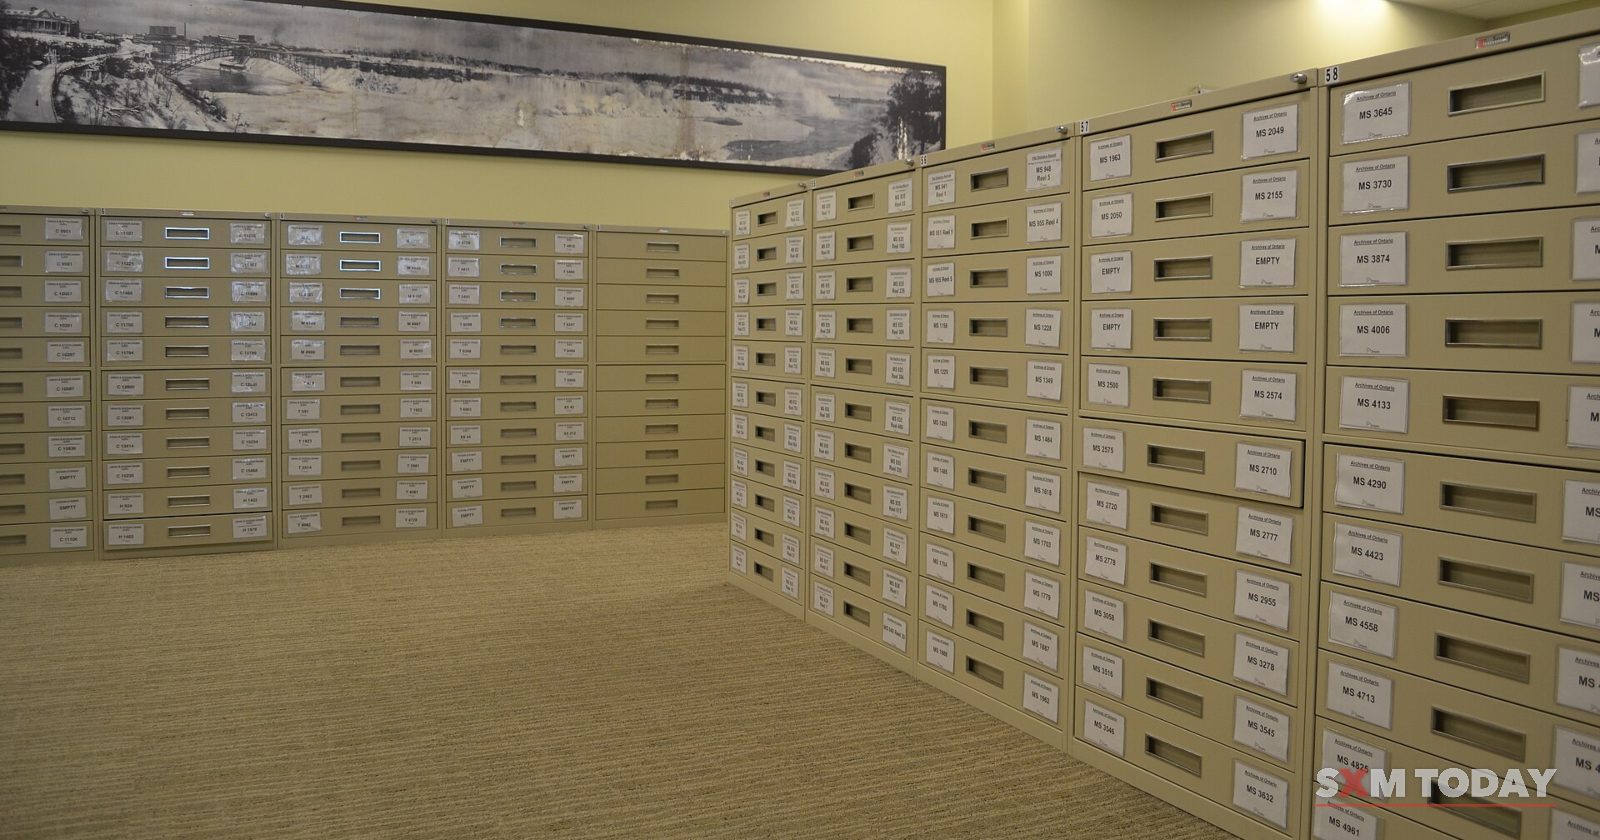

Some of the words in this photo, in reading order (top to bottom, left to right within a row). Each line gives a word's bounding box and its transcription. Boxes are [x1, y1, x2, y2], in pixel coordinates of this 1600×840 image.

[1326, 67, 1338, 82] 58
[1360, 110, 1371, 120] MS
[1374, 107, 1392, 118] 3645
[1081, 121, 1088, 132] 57
[1256, 128, 1266, 138] MS
[1268, 126, 1284, 136] 2049
[1109, 154, 1120, 162] 1963
[1358, 182, 1370, 190] MS
[1373, 180, 1392, 189] 3730
[1267, 191, 1283, 200] 2155
[1357, 256, 1369, 264] MS
[1371, 255, 1390, 263] 3874
[1102, 267, 1120, 275] EMPTY
[1254, 390, 1264, 398] MS
[1266, 391, 1282, 399] 2574
[1357, 398, 1369, 408] MS
[1371, 400, 1391, 410] 4133
[1102, 446, 1114, 454] 2575
[1249, 464, 1259, 473] MS
[1261, 466, 1277, 475] 2710
[1353, 476, 1365, 486] MS
[1367, 478, 1386, 489] 4290
[1096, 500, 1104, 508] MS
[1106, 502, 1117, 510] 2720
[1250, 528, 1260, 538] MS
[1262, 531, 1278, 541] 2777
[1348, 530, 1366, 539] Archives
[1372, 535, 1388, 543] Ontario
[1095, 554, 1103, 563] MS
[1351, 546, 1363, 556] MS
[1365, 549, 1384, 560] 4423
[1033, 589, 1040, 597] MS
[1248, 592, 1258, 602] MS
[1260, 595, 1276, 606] 2955
[1583, 590, 1599, 602] MS
[1343, 600, 1361, 610] Archives
[1367, 606, 1382, 615] Ontario
[1094, 609, 1102, 617] MS
[1103, 611, 1114, 621] 3058
[1345, 616, 1357, 627] MS
[1359, 619, 1378, 632] 4558
[1032, 640, 1038, 648] MS
[1092, 665, 1100, 673] MS
[1247, 656, 1257, 665] MS
[1259, 659, 1274, 671] 3278
[1340, 670, 1358, 680] Archives
[1364, 676, 1379, 686] Ontario
[1578, 676, 1595, 688] MS
[1032, 691, 1038, 700] MS
[1342, 686, 1354, 698] MS
[1356, 690, 1375, 703] 4713
[1094, 720, 1102, 729] MS
[1248, 720, 1257, 731] MS
[1259, 724, 1274, 737] 3545
[1334, 738, 1352, 750] Archives
[1358, 746, 1373, 757] Ontario
[1337, 754, 1348, 766] MS
[1575, 758, 1592, 770] MS
[1246, 785, 1256, 796] MS
[1258, 789, 1274, 803] 3632
[1328, 816, 1340, 829] MS
[1342, 821, 1360, 837] 4961
